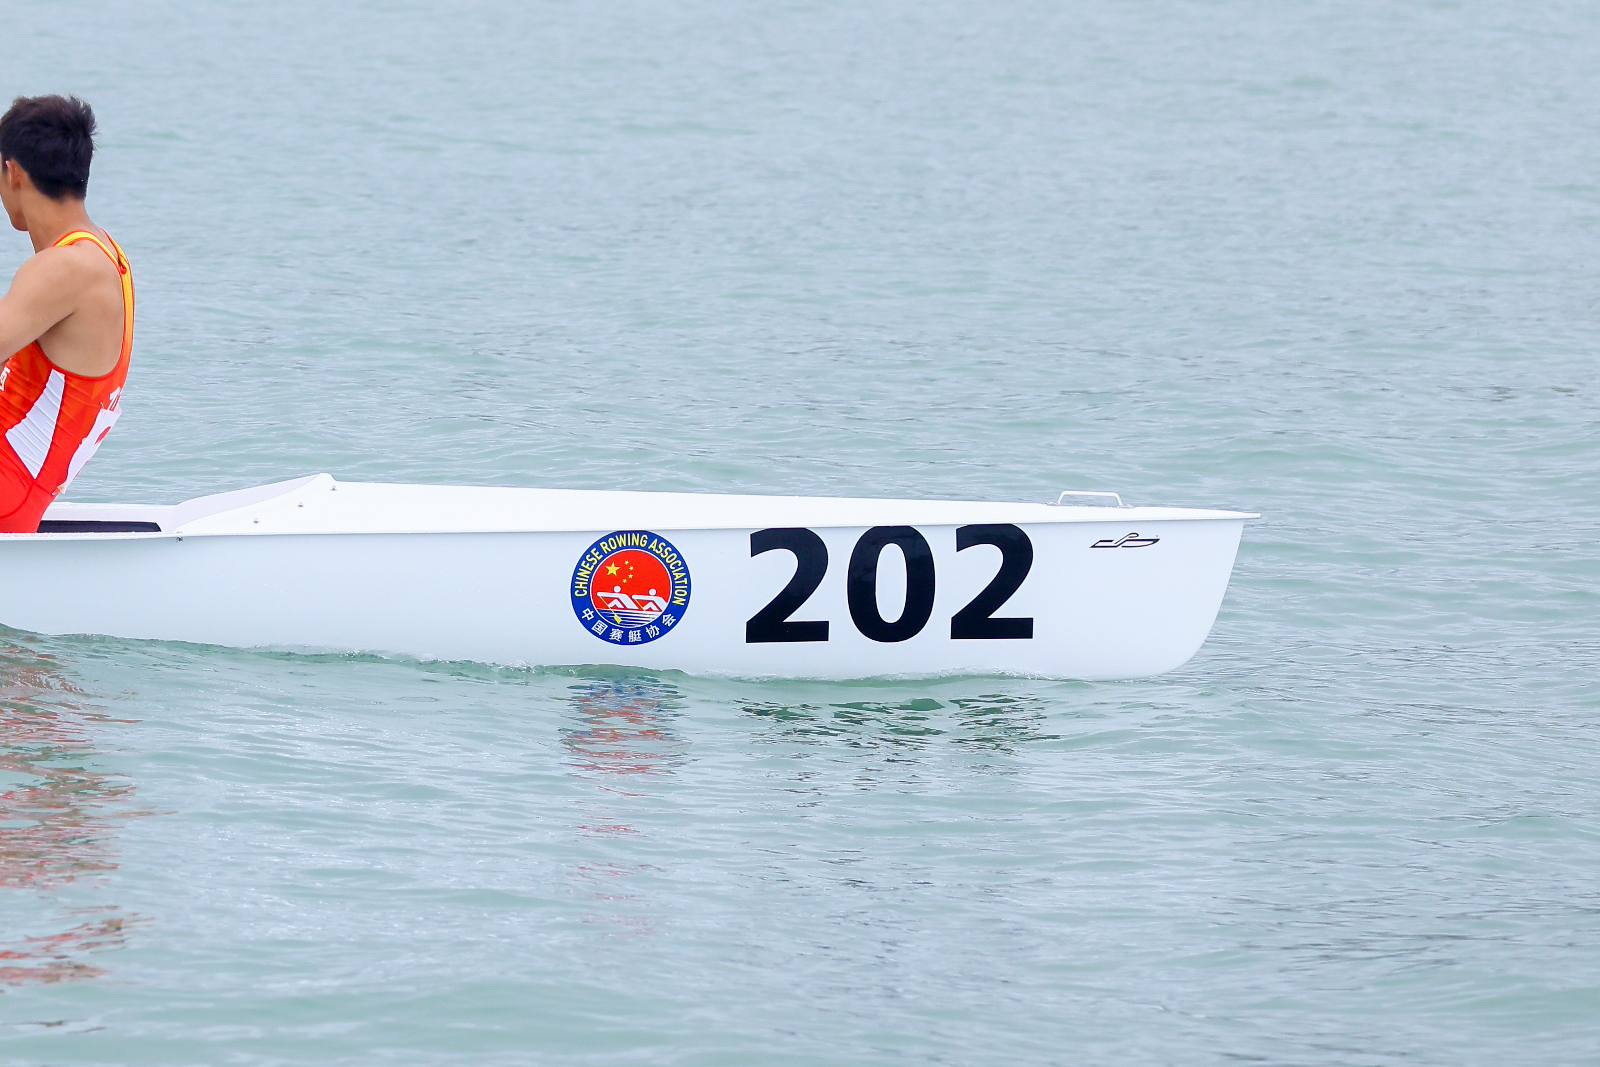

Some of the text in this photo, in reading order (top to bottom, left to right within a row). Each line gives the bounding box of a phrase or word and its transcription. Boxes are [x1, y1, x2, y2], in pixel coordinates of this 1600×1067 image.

[574, 533, 688, 606] CHINESE ROWING ASSOCIATION
[746, 523, 1034, 643] 202
[581, 607, 677, 643] 中国赛艇协会
